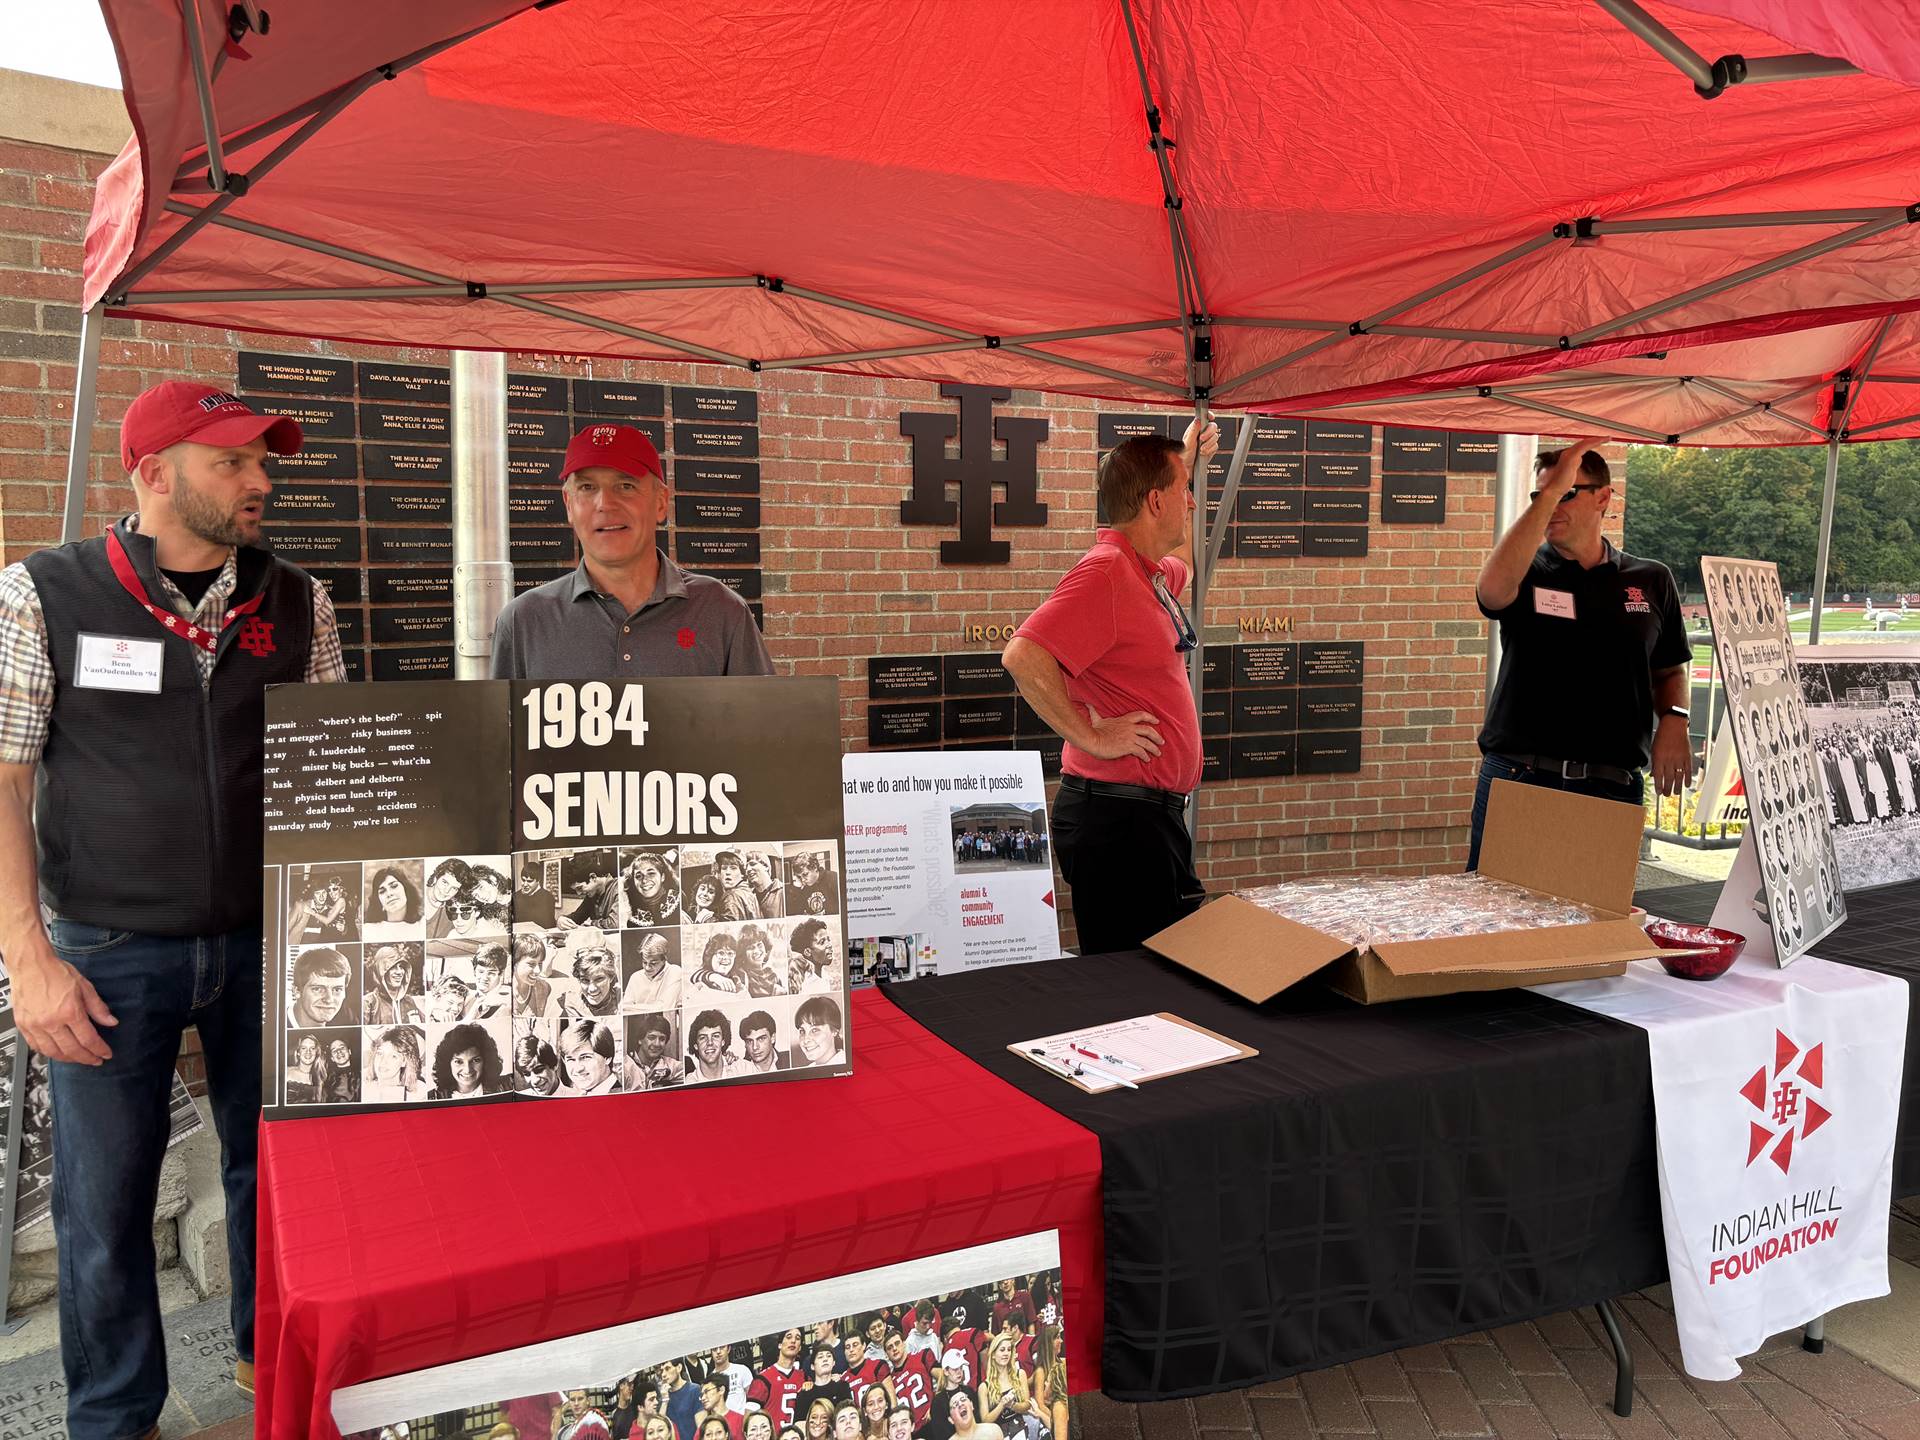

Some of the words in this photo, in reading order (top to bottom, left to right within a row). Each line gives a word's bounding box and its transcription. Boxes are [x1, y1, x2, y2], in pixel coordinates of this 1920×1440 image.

[1625, 604, 1650, 613] BRAVES
[1239, 617, 1296, 633] MIAMI
[111, 660, 131, 668] Benn
[267, 721, 297, 732] pursuit
[319, 716, 356, 727] "where's
[359, 715, 372, 724] the
[375, 713, 402, 722] beef?"
[425, 712, 442, 722] spit
[522, 681, 648, 750] 1984
[278, 735, 286, 743] at
[290, 732, 329, 745] metzger's
[351, 729, 373, 739] risky
[376, 727, 412, 737] business
[273, 750, 287, 760] say
[309, 748, 317, 757] ft.
[321, 745, 366, 755] lauderdale
[302, 763, 328, 772] mister
[332, 761, 346, 771] big
[350, 760, 374, 769] bucks
[392, 757, 431, 767] what'cha
[273, 780, 293, 789] hask
[315, 777, 346, 787] delbert
[350, 776, 365, 785] and
[368, 774, 404, 784] delberta
[860, 780, 874, 794] we
[878, 777, 889, 793] do
[892, 776, 910, 792] and
[913, 776, 932, 792] how
[934, 779, 950, 794] you
[954, 775, 978, 790] make
[980, 774, 987, 789] it
[989, 774, 1023, 793] possible
[295, 792, 326, 804] physics
[350, 790, 374, 799] lunch
[377, 789, 397, 799] trips
[265, 809, 283, 817] mits
[306, 806, 326, 815] dead
[330, 805, 354, 814] heads
[377, 801, 417, 812] accidents
[522, 770, 738, 841] SENIORS
[268, 822, 305, 832] saturday
[309, 820, 331, 830] study
[353, 817, 380, 828] you're
[383, 816, 400, 825] lost
[865, 824, 908, 837] programming
[961, 888, 980, 899] alumni
[982, 887, 987, 897] &
[961, 900, 993, 913] community
[962, 914, 1004, 927] ENGAGEMENT
[1712, 1198, 1787, 1252] INDIAN
[1792, 1186, 1842, 1223] HILL
[1709, 1218, 1839, 1285] FOUNDATION
[782, 1392, 797, 1427] 5
